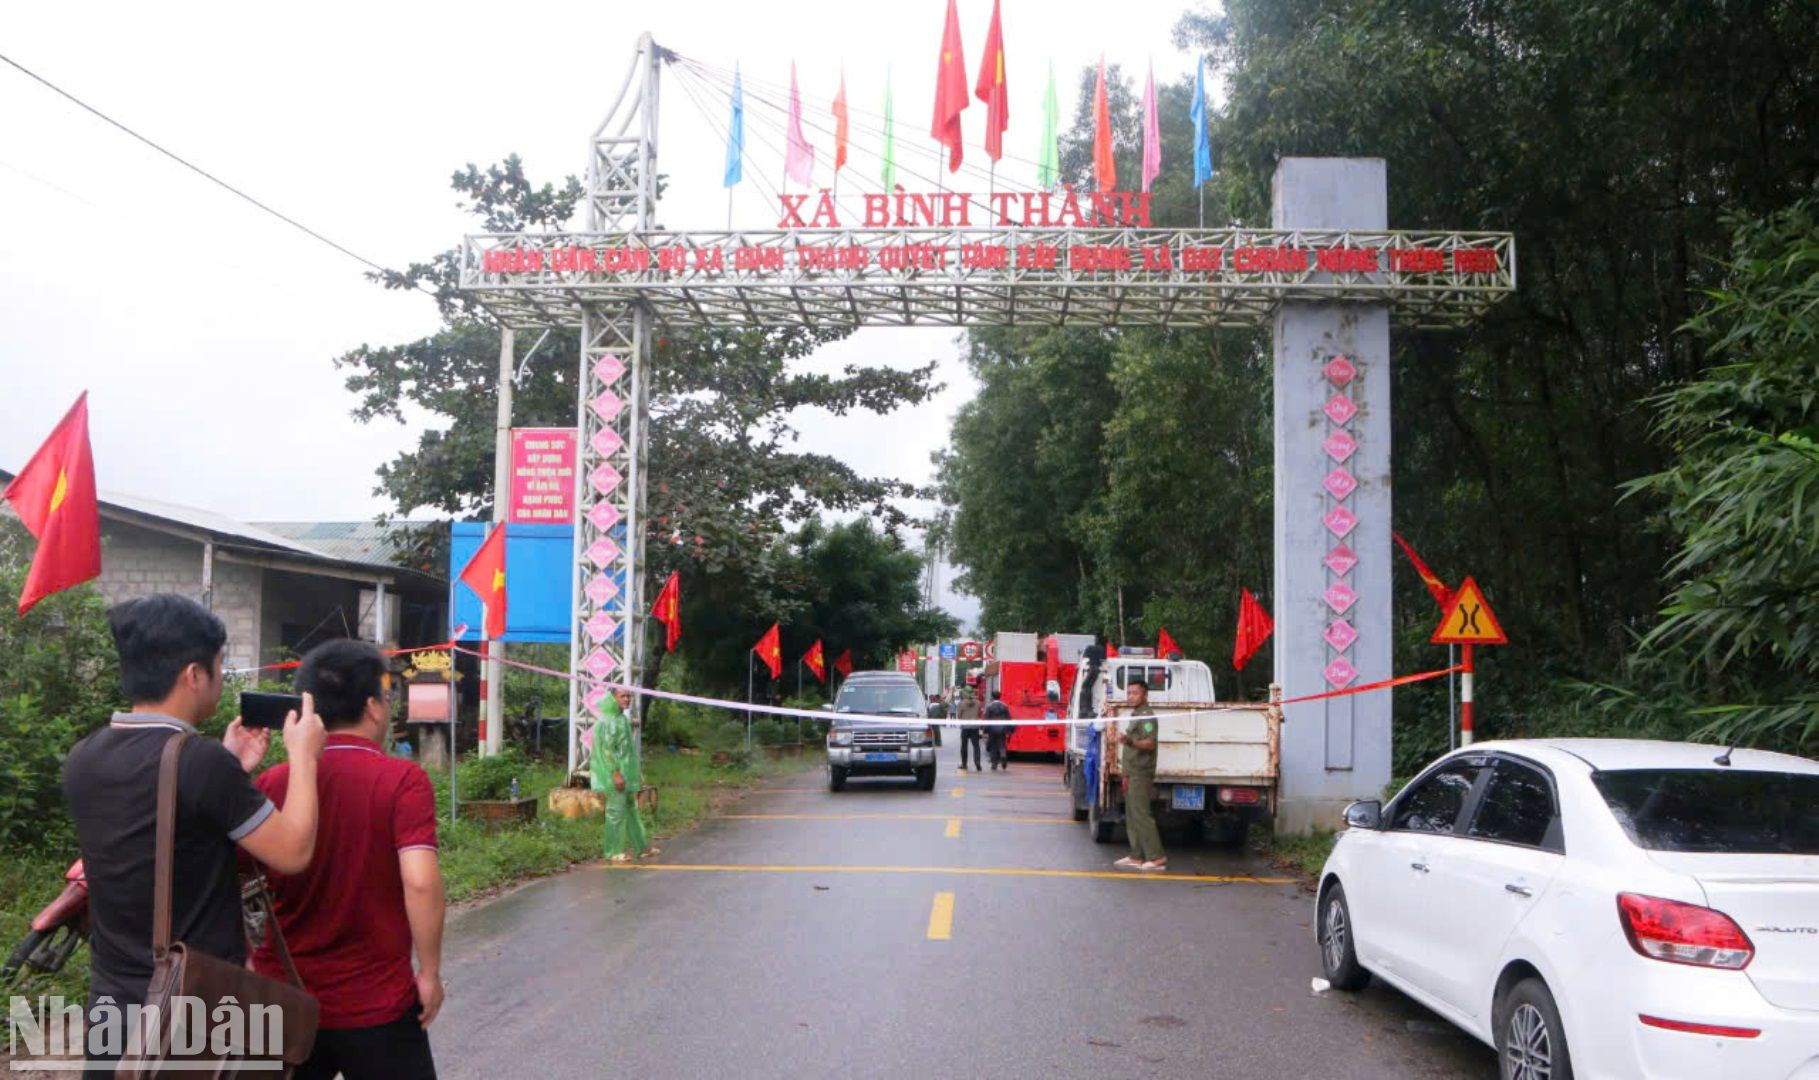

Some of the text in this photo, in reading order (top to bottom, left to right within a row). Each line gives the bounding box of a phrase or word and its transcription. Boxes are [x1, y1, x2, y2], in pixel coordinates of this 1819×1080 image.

[777, 183, 1153, 227] XÃ BÌNH THÀNH
[658, 243, 686, 275] BỘ
[796, 242, 869, 270] THÀNH
